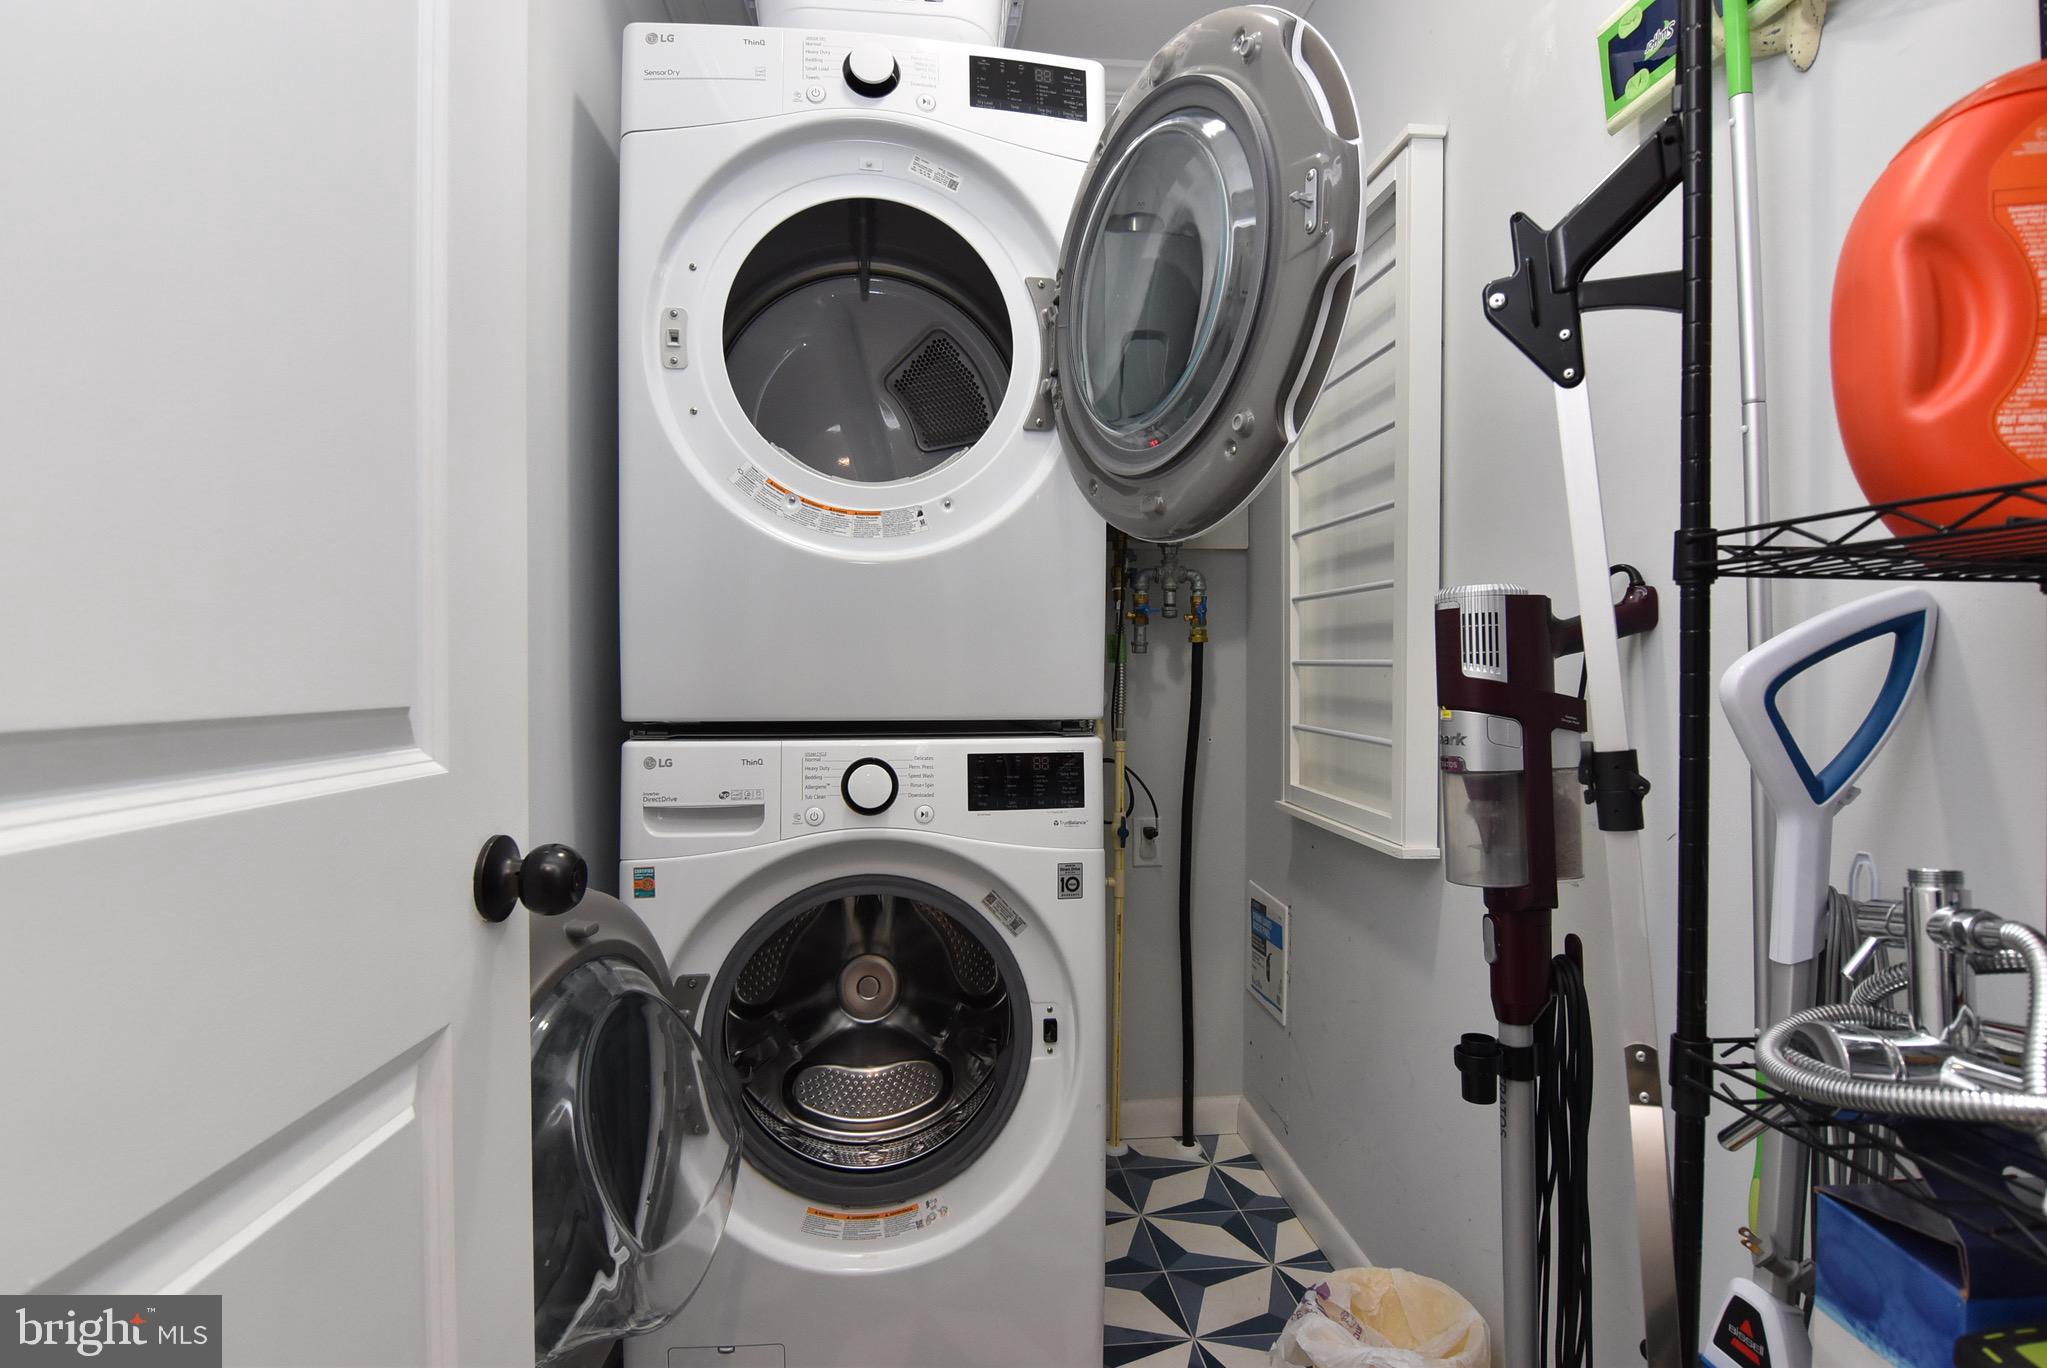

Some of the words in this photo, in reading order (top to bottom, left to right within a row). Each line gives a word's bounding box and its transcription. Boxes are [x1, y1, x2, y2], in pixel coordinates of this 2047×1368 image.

[660, 34, 675, 43] LG
[743, 39, 766, 47] ThinQ
[659, 758, 673, 768] LG
[1060, 876, 1081, 893] 10
